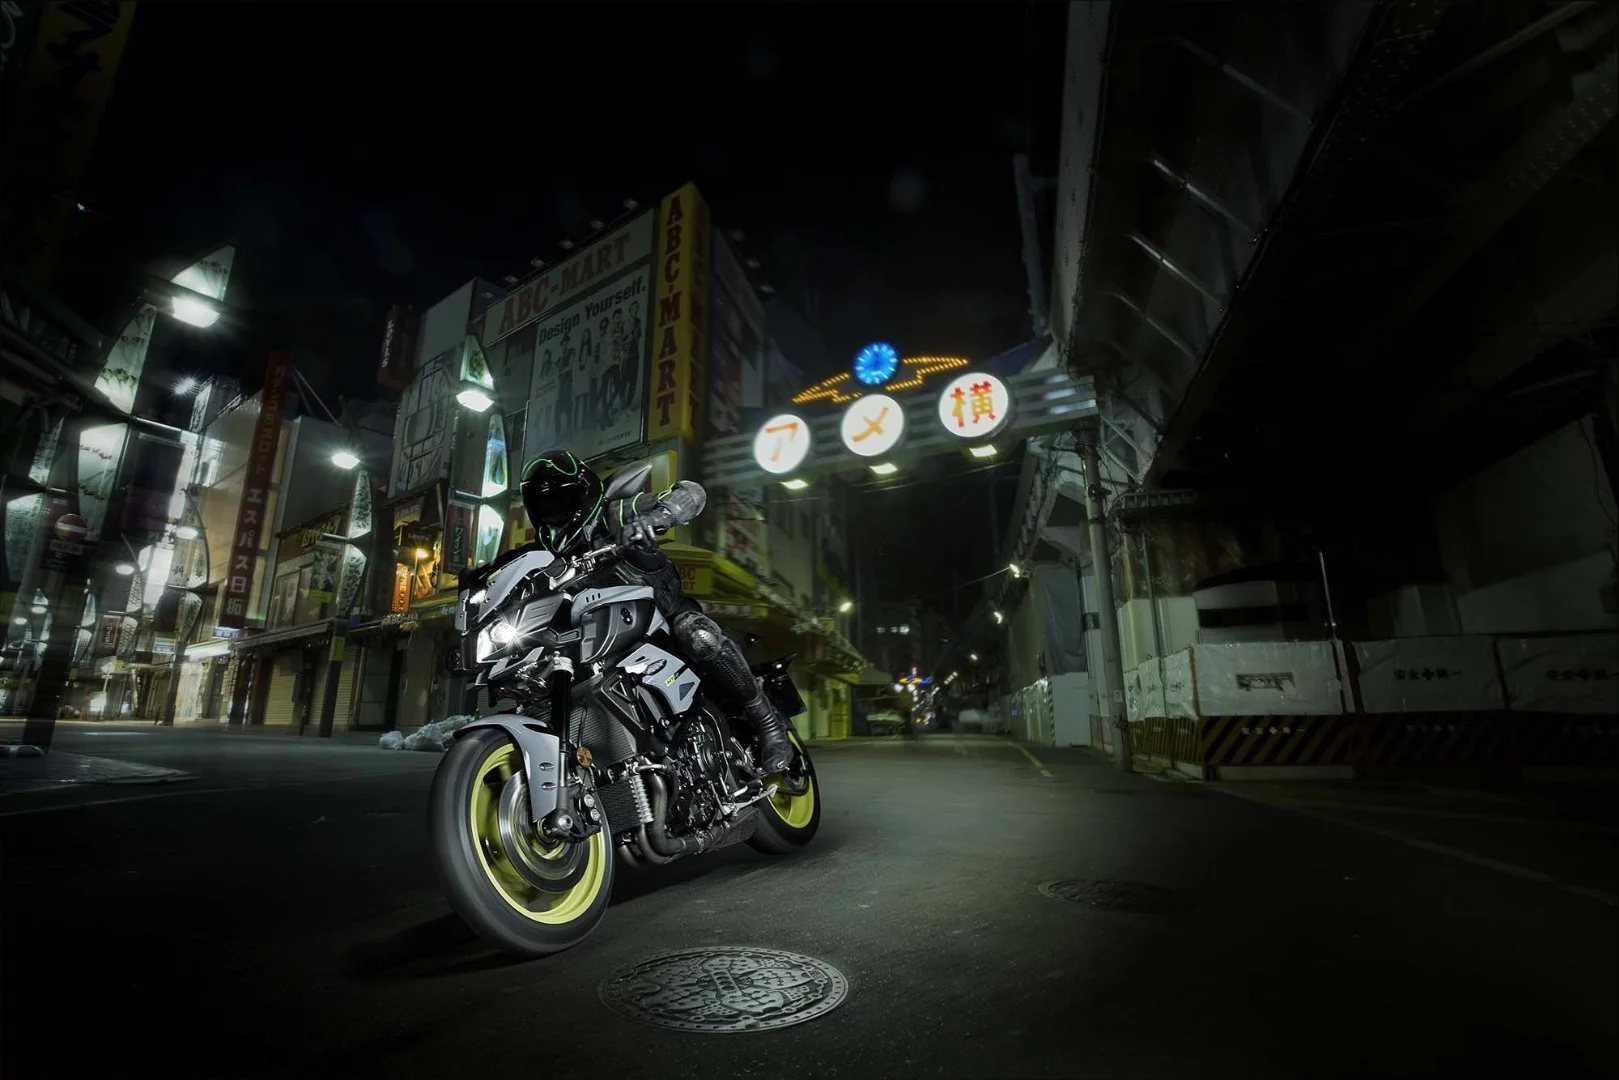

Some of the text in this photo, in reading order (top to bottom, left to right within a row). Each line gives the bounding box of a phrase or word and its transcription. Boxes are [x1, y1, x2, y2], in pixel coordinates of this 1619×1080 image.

[499, 232, 632, 334] ABC-MART
[538, 313, 581, 346] Design
[657, 195, 683, 427] ABC-MART
